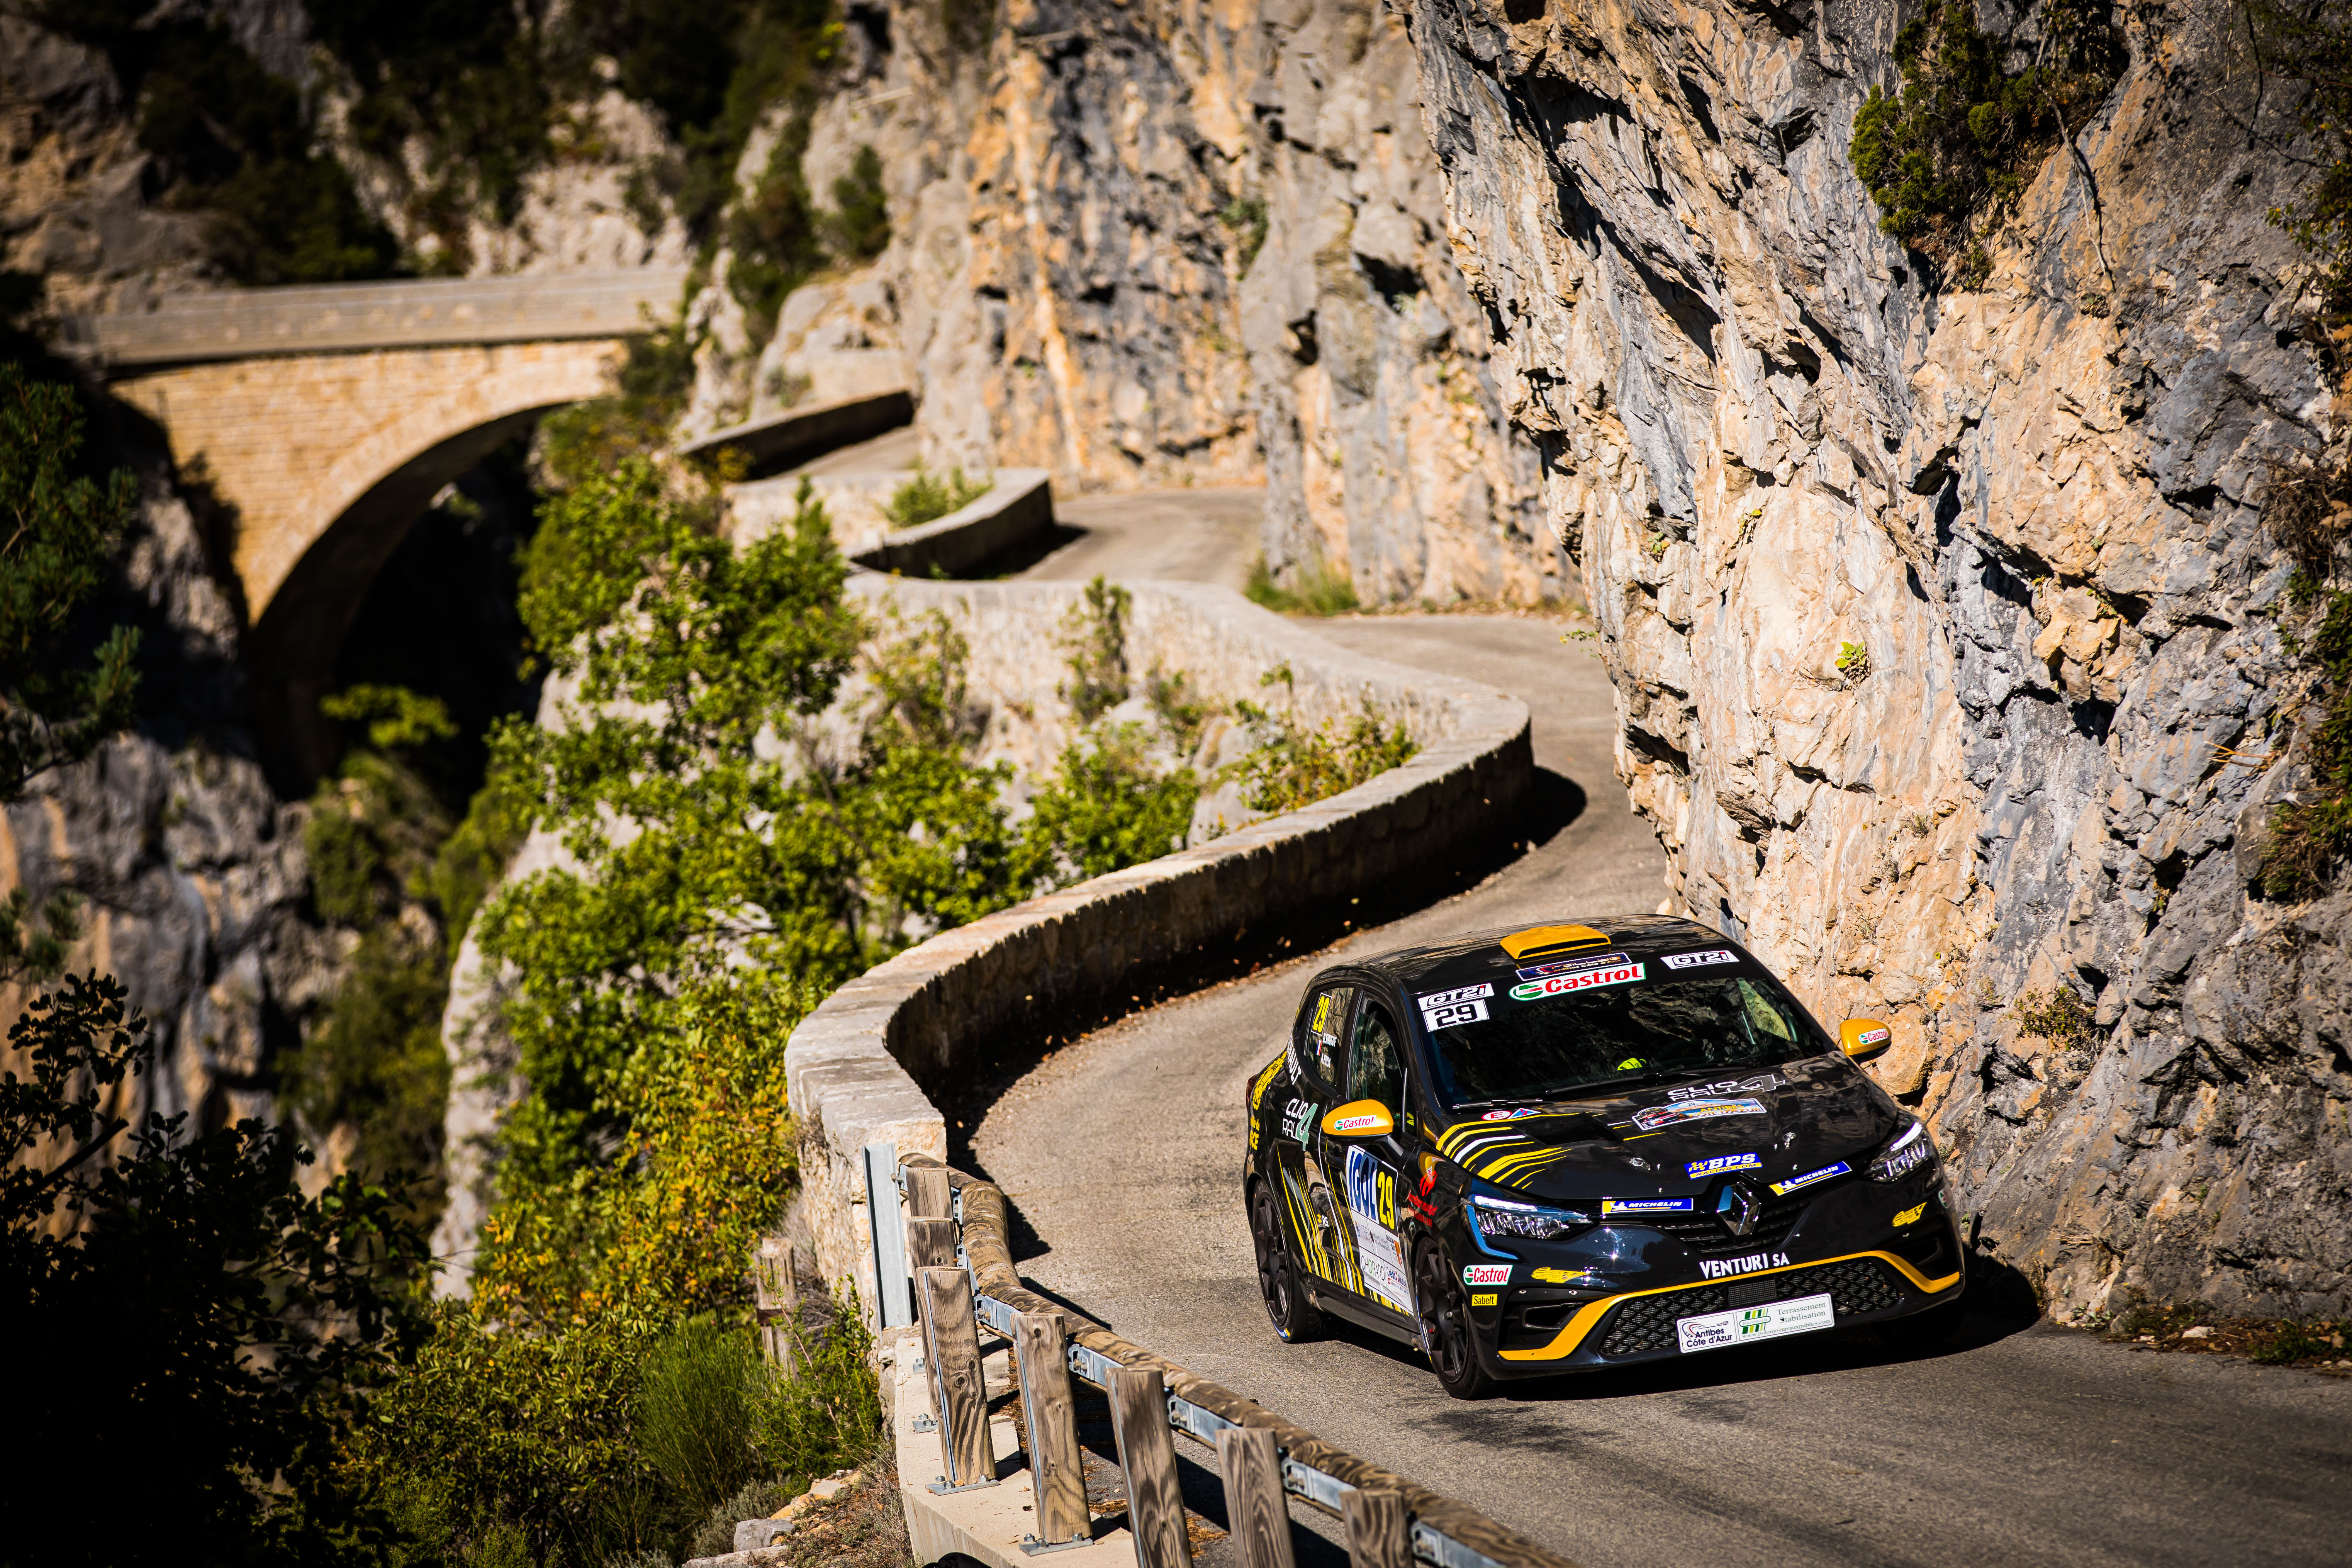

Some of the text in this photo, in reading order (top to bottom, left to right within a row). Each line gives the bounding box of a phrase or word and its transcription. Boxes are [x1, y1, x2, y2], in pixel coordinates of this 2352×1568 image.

[1672, 952, 1729, 966] GT2i
[1545, 966, 1642, 993] Castrol
[1427, 985, 1486, 1006] GT2i
[1313, 996, 1330, 1033] 29
[1434, 1004, 1478, 1027] 29
[1868, 1030, 1888, 1041] Castrol
[1287, 1033, 1302, 1085] NAULT
[1667, 1081, 1738, 1096] CLIO
[1286, 1098, 1308, 1119] CLIO
[1700, 1104, 1744, 1112] ANTIBES
[1344, 1117, 1374, 1128] Castrol
[1709, 1154, 1756, 1169] BPS
[1696, 1164, 1756, 1176] RACING.COM
[1795, 1166, 1838, 1183] MICHELIN
[1349, 1151, 1376, 1221] IGOL
[1378, 1171, 1394, 1229] 29
[1322, 1215, 1329, 1227] RS
[1361, 1255, 1385, 1281] CHOPARD
[1699, 1252, 1790, 1279] VENTURI SA
[1474, 1268, 1509, 1283] Castrol
[1474, 1296, 1494, 1305] Sabelt
[1777, 1302, 1826, 1315] Terrassement
[1780, 1311, 1826, 1323] Stabilisation
[1687, 1335, 1732, 1347] Côte d'Azur
[1695, 1329, 1724, 1338] Antibes
